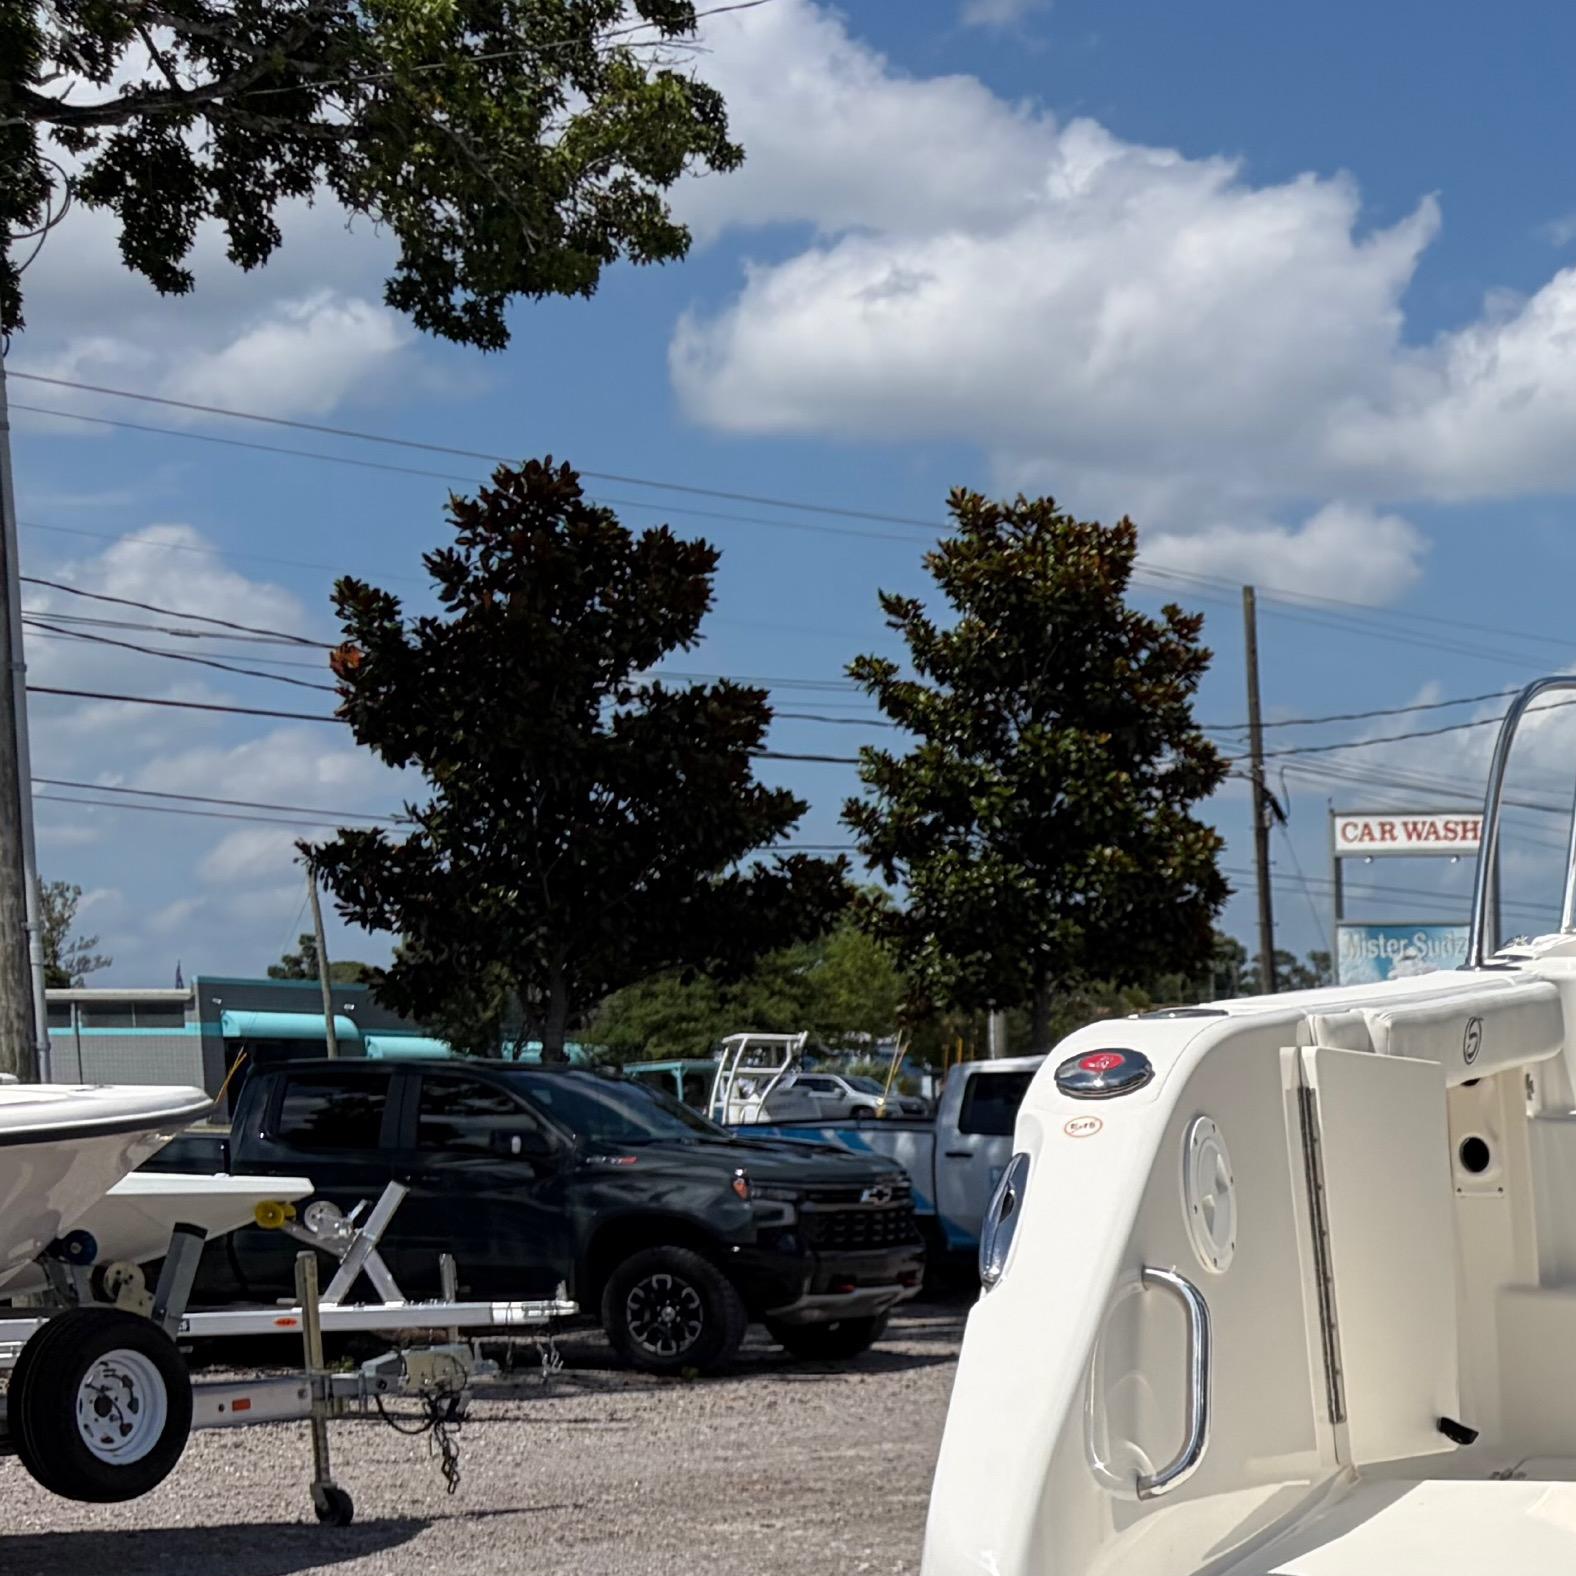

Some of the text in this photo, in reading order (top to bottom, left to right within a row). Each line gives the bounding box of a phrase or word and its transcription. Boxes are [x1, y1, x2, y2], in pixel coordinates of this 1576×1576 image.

[1341, 820, 1480, 843] CAR WASH
[1343, 931, 1467, 959] Mister Sudz
